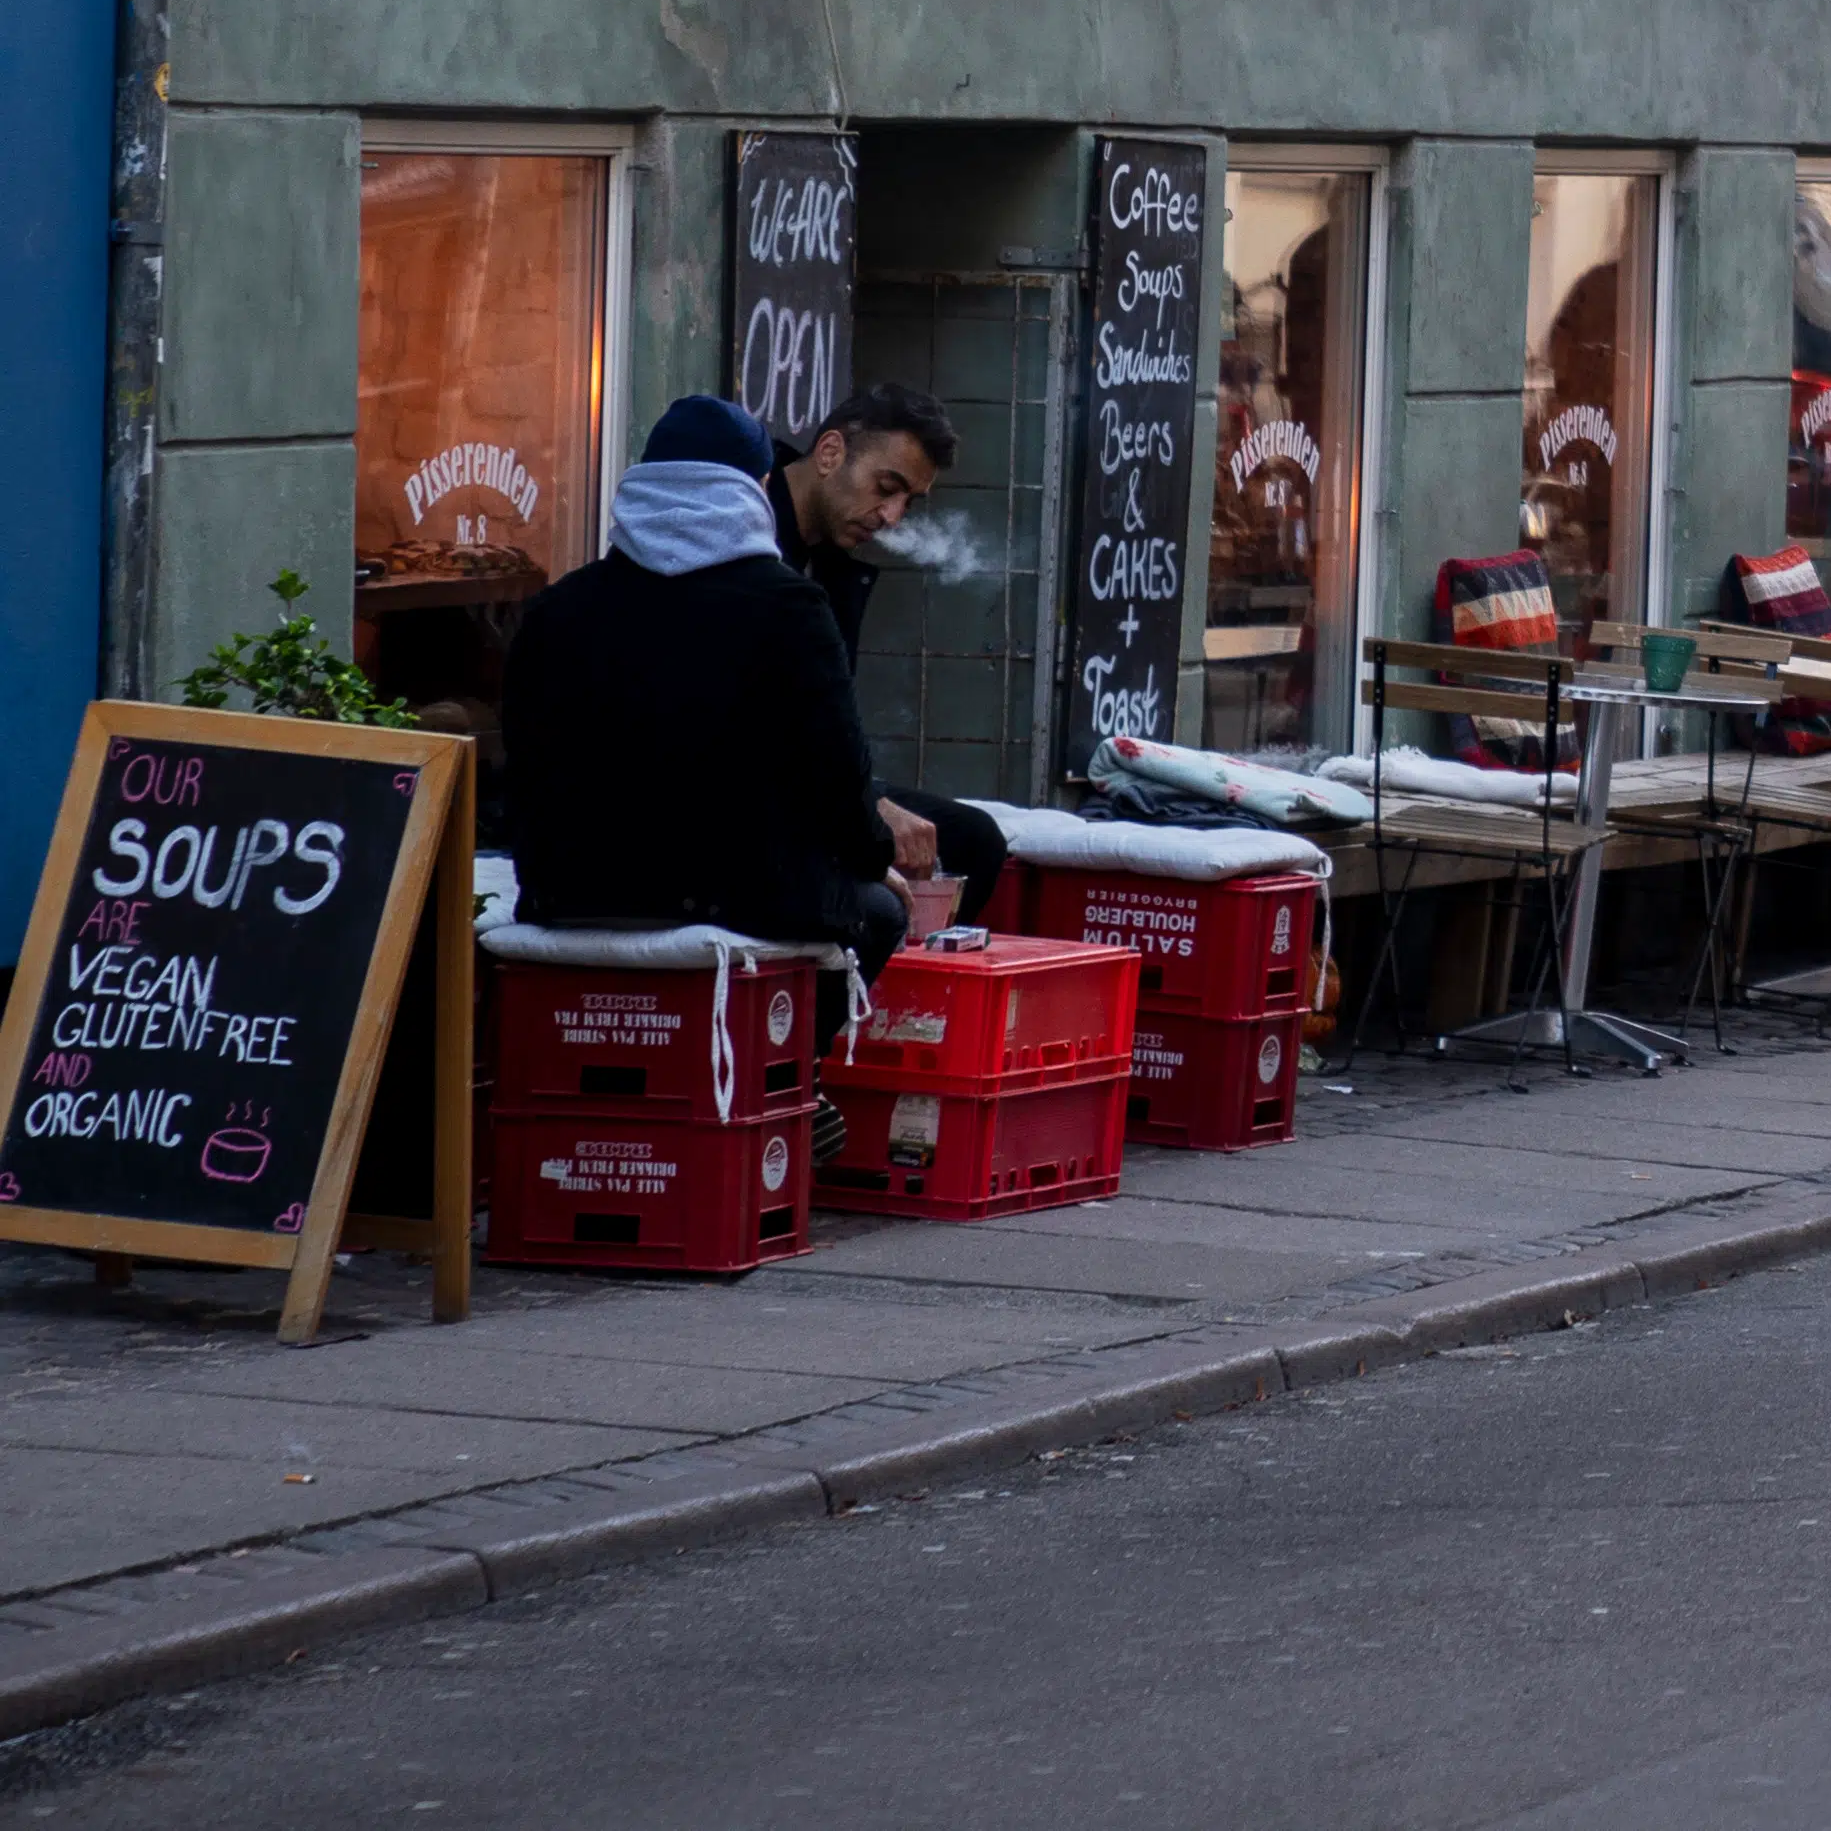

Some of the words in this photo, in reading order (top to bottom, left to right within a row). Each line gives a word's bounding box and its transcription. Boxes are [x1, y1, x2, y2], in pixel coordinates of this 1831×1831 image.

[791, 177, 848, 265] ARE
[1109, 164, 1199, 233] Coffee
[1117, 250, 1183, 329] Soups
[741, 297, 835, 434] OPEN
[1096, 328, 1190, 388] Sandwiches
[1100, 399, 1171, 474] Beers
[1229, 418, 1320, 494] Pisserenden
[1538, 404, 1617, 469] Pisserenden
[404, 441, 539, 526] Pisserenden
[1122, 468, 1145, 532] &
[456, 514, 474, 545] Nr.
[476, 514, 487, 544] 8
[1089, 536, 1177, 601] CAKES
[1083, 656, 1159, 737] Toast
[121, 755, 204, 806] OUR
[93, 819, 345, 914] SOUPS
[78, 901, 150, 945] ARE
[1085, 905, 1196, 932] HOULBJERG
[1087, 889, 1197, 909] BRYGGERIER
[1083, 928, 1194, 957] SALTUM
[69, 944, 217, 1011] VEGAN
[53, 1002, 297, 1065] GLUTENFREE
[583, 1011, 619, 1028] FREM
[623, 1013, 681, 1030] DRIKKER
[640, 1031, 671, 1046] ALLE
[33, 1054, 92, 1087] AND
[24, 1092, 192, 1148] ORGANIC
[579, 1159, 614, 1175] FREM
[619, 1161, 677, 1177] DRIKKER
[636, 1178, 666, 1194] ALLE
